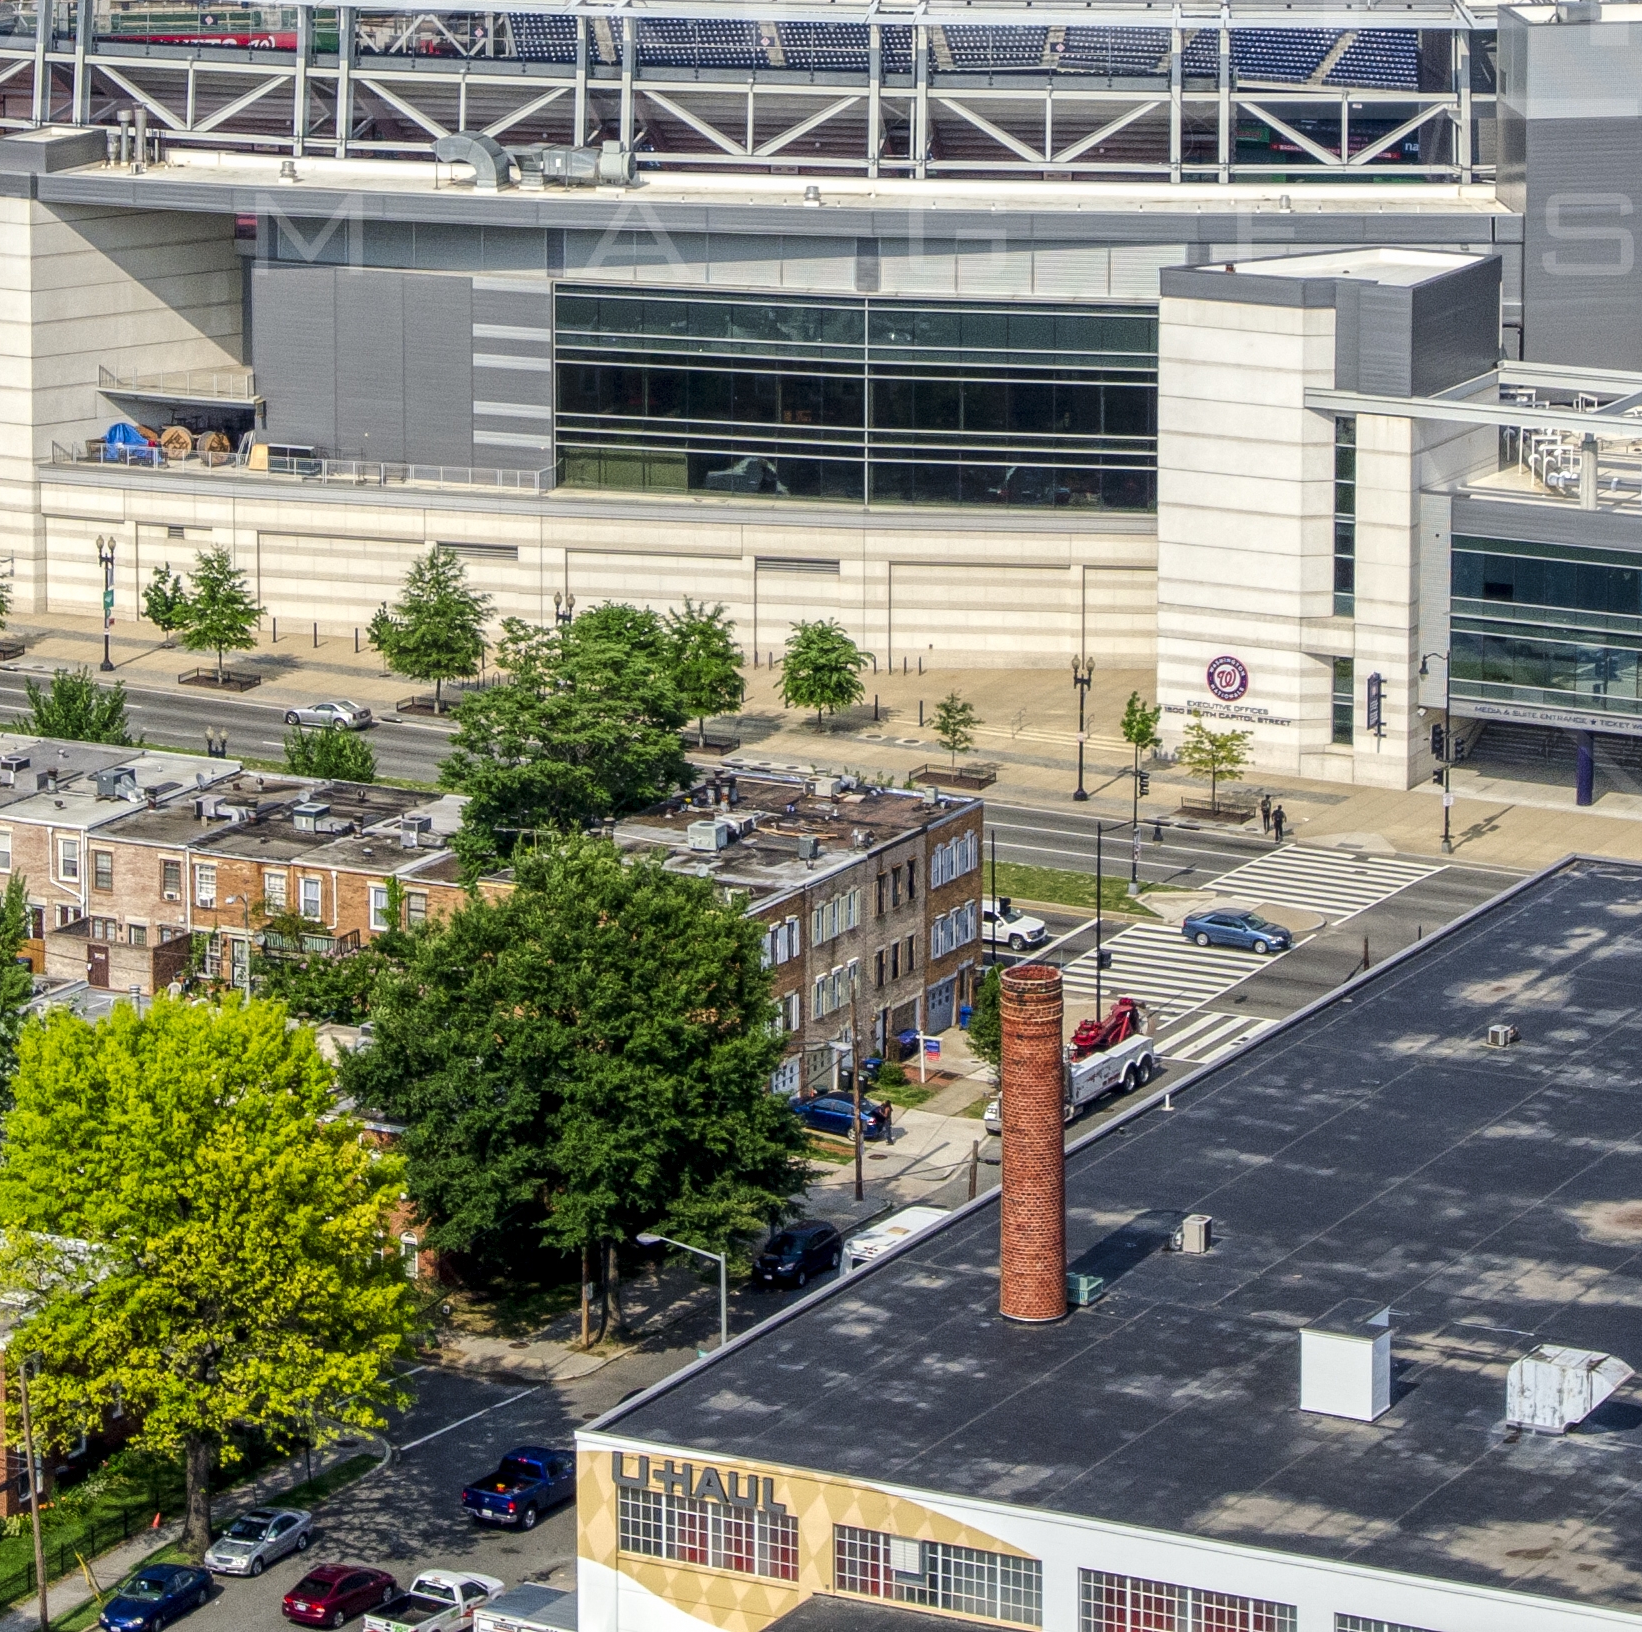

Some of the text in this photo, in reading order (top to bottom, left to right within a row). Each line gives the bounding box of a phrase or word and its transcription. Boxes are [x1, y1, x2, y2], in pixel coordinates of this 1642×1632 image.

[1210, 657, 1246, 677] WASHINGTON
[1210, 683, 1245, 699] NATIONALS
[1187, 700, 1269, 715] EXECUTIVE OFFICES
[1218, 712, 1256, 723] CAPITOL
[1257, 717, 1292, 727] STREET
[1474, 705, 1502, 715] MEDIA
[1512, 709, 1537, 719] SUITE
[1539, 713, 1588, 725] ENTRANCE
[1599, 719, 1631, 729] TICKET
[612, 1450, 787, 1515] U-HAUL
